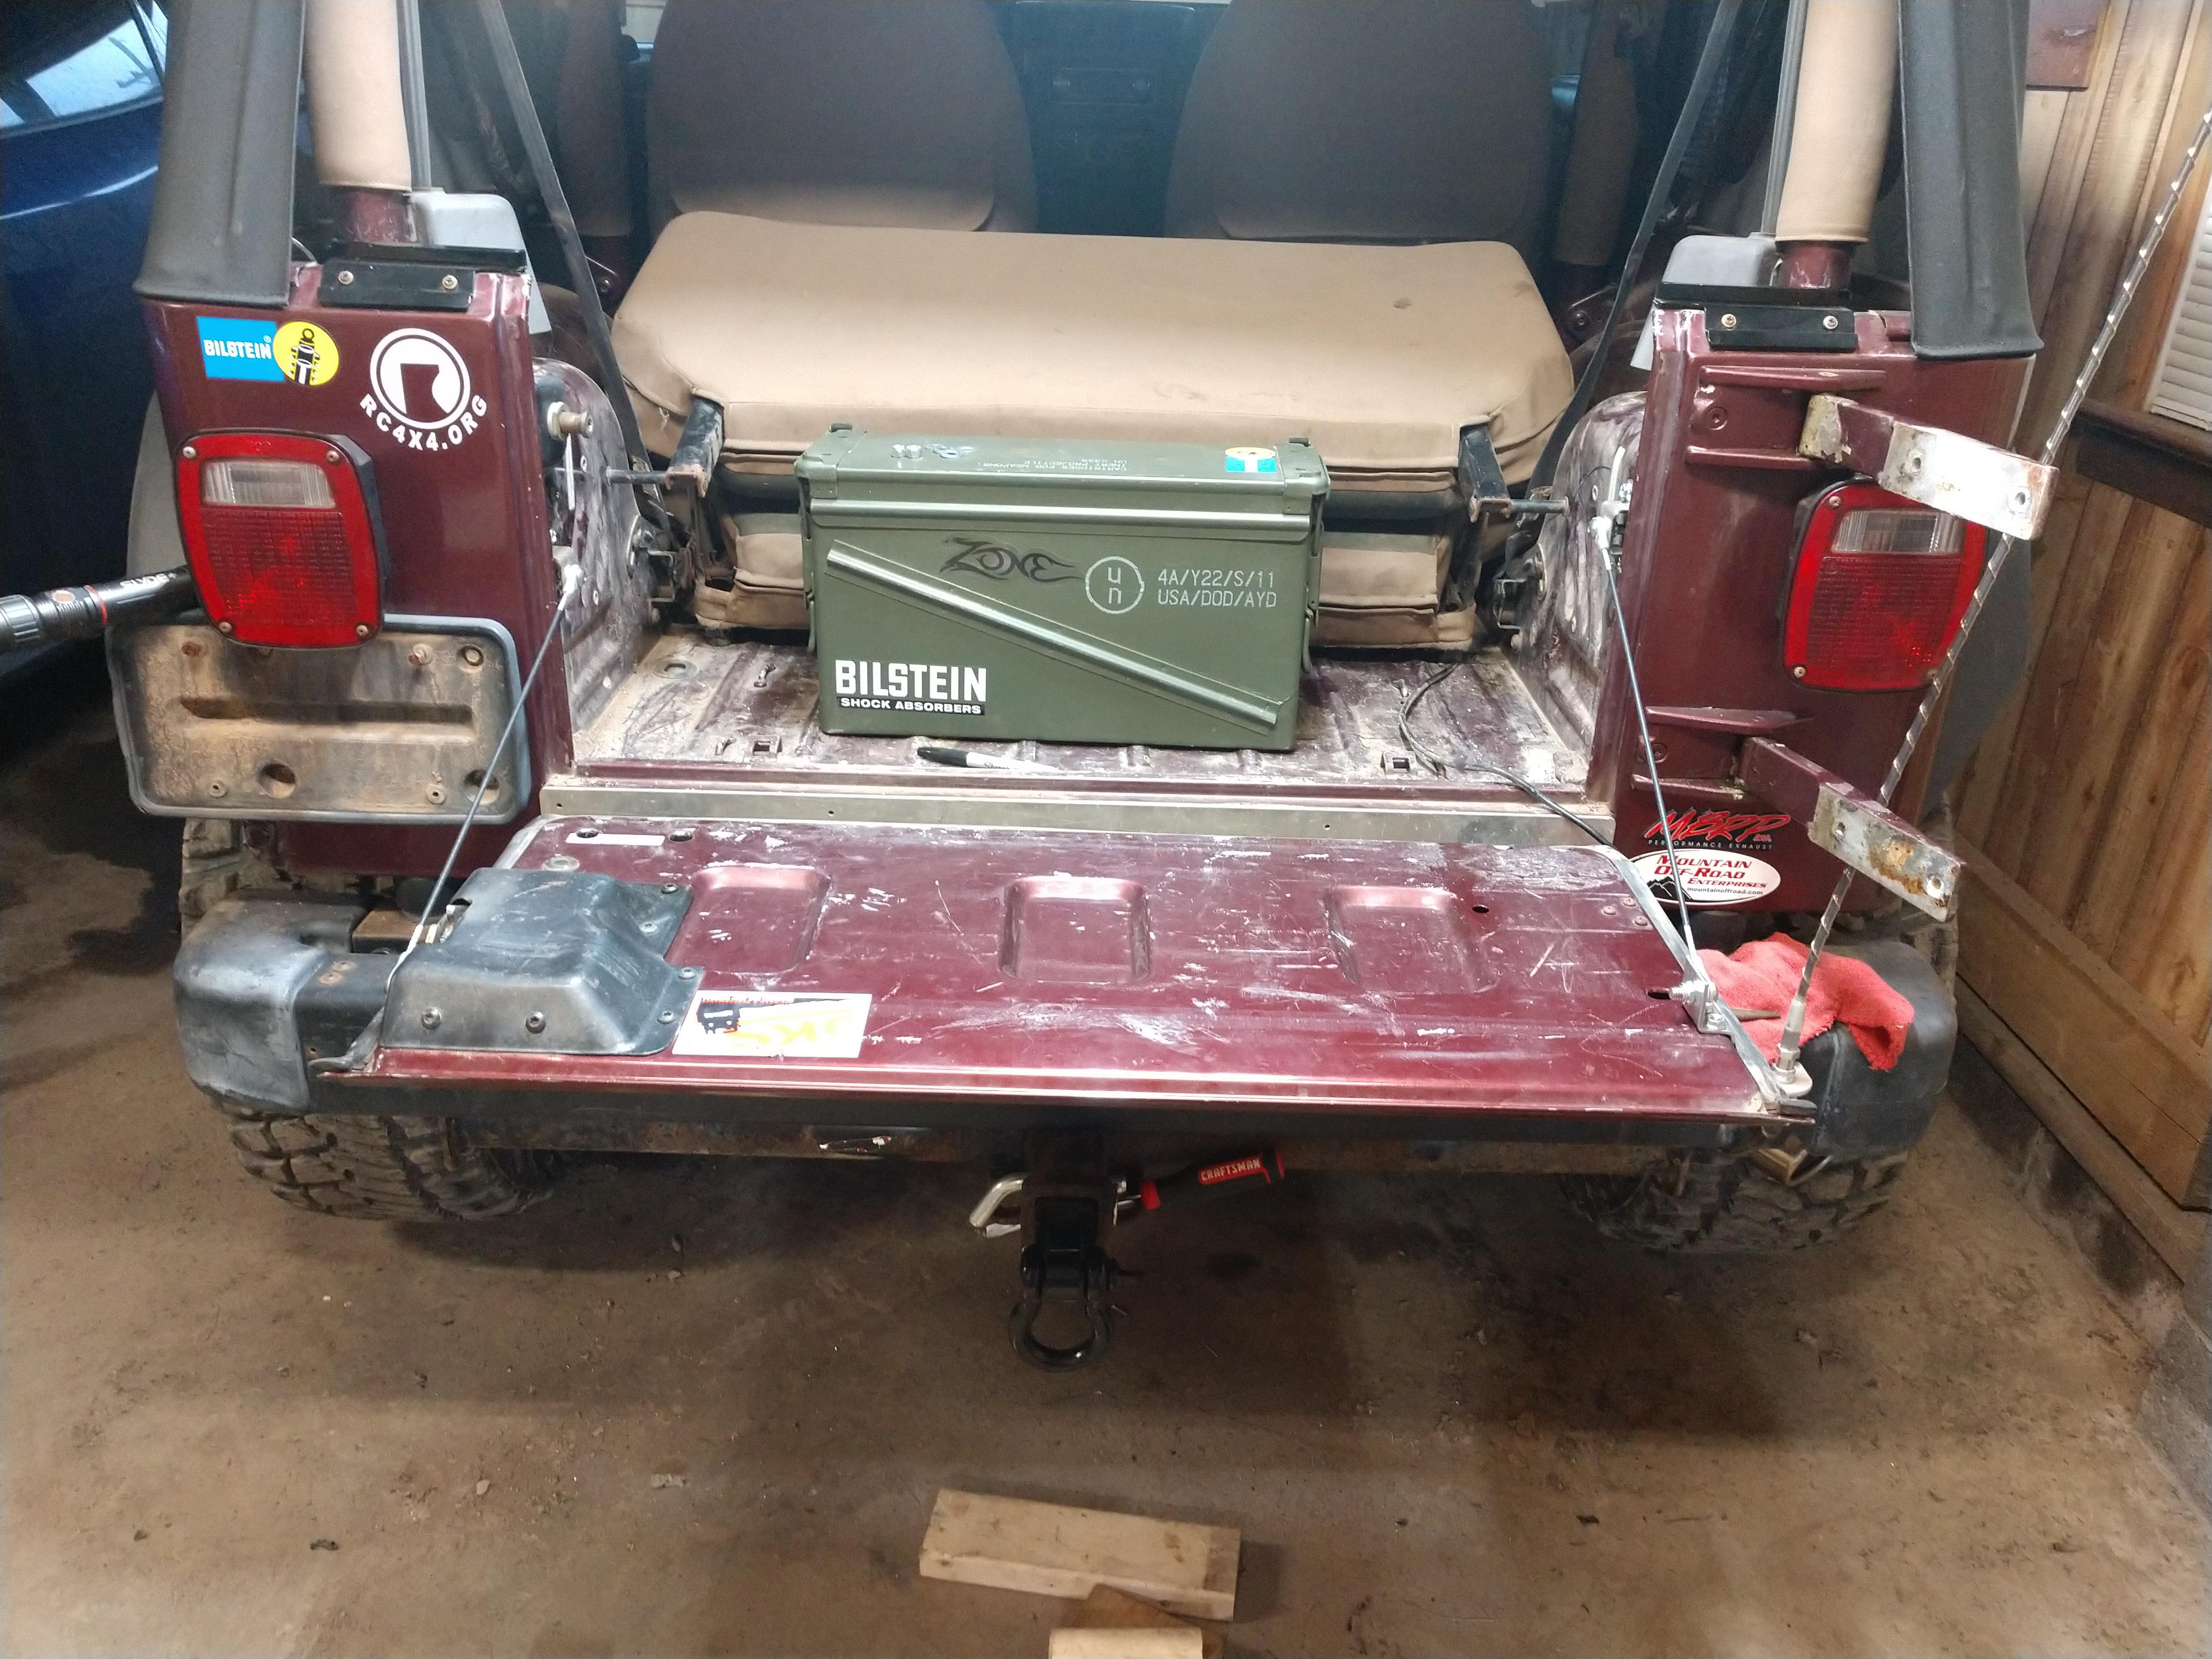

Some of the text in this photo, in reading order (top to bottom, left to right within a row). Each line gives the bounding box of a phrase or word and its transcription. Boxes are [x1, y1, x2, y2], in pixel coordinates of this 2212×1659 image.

[204, 339, 272, 359] BILSTEIN
[360, 393, 487, 451] RC4X4.ORG
[1158, 569, 1274, 587] 4A/Y22/S/11
[1158, 589, 1277, 608] USA/DOD/AYD
[835, 659, 987, 702] BILSTEIN
[840, 697, 982, 714] SHOCK ABSORBERS
[1648, 839, 1721, 848] PERORMANCE
[1687, 878, 1768, 888] ENTERPRISES
[1201, 1158, 1261, 1181] CRAFTSMAN
